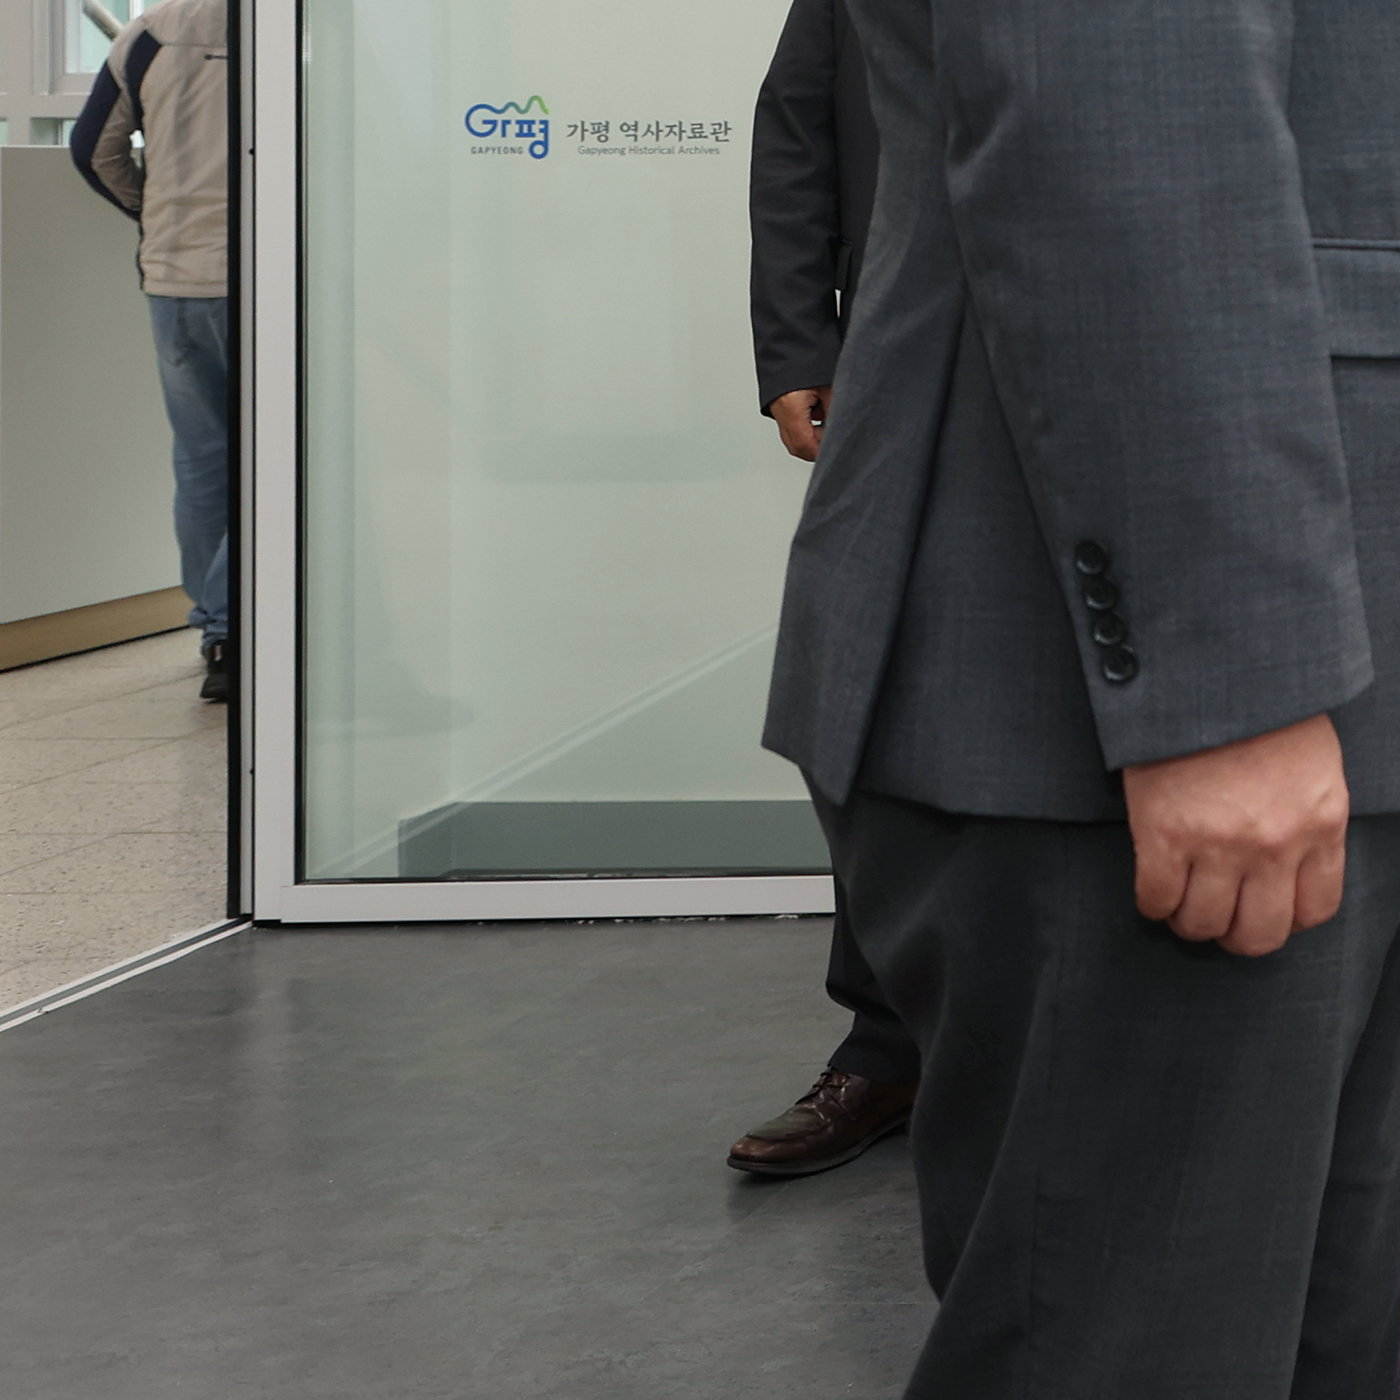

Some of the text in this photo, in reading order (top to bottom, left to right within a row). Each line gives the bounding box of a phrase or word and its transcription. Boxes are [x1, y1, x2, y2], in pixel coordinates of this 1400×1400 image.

[566, 120, 733, 143] 가평 역사자료관
[470, 146, 524, 155] GAPYEONG
[577, 144, 720, 157] Gapyeong Historical Archives
